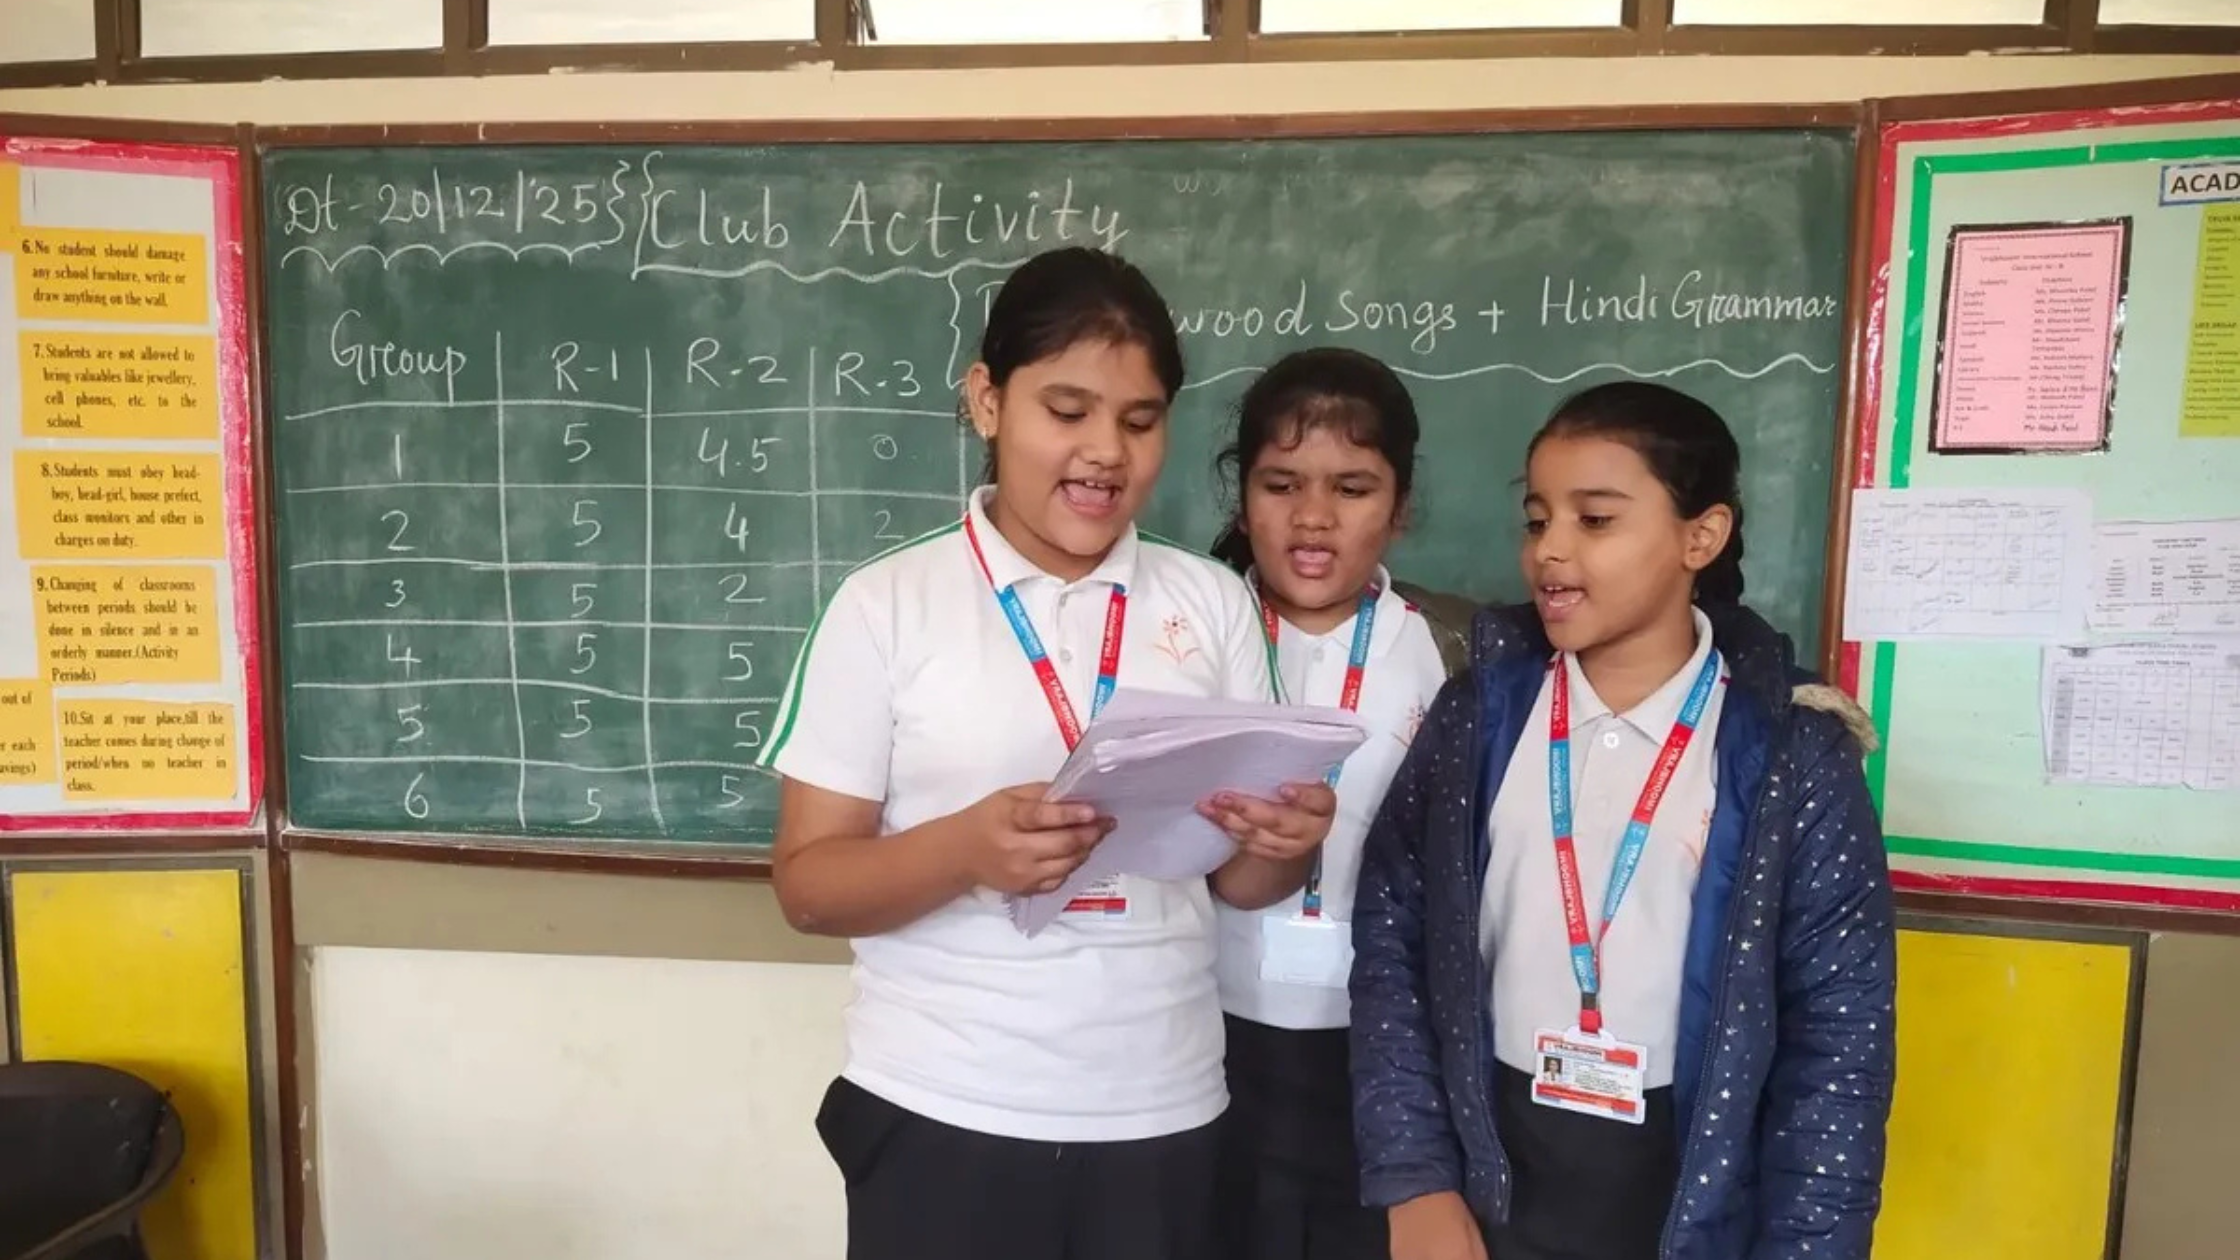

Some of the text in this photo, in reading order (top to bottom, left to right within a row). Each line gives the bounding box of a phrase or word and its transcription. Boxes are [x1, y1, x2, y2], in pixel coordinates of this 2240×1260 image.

[651, 178, 1129, 256] Club Activity
[58, 241, 96, 257] student
[104, 243, 138, 258] should
[146, 245, 185, 262] damage
[32, 267, 51, 281] any
[55, 264, 89, 280] school
[145, 271, 171, 283] write
[175, 274, 185, 284] or
[33, 288, 60, 302] draw
[63, 289, 107, 306] anything
[110, 295, 123, 305] on
[125, 291, 142, 305] the
[1325, 290, 1456, 355] Songs
[1478, 300, 1504, 334] +
[1541, 274, 1657, 326] Hindi
[96, 349, 113, 359] are
[119, 349, 135, 360] not
[141, 346, 179, 361] allowed
[184, 348, 194, 361] to
[552, 342, 618, 392] R-1
[687, 337, 788, 389] R-2
[836, 351, 922, 397] R-3
[43, 367, 71, 384] bring
[75, 368, 122, 383] valuables
[125, 369, 143, 383] like
[44, 391, 64, 405] cell
[158, 395, 169, 407] to
[181, 393, 197, 407] the
[394, 434, 402, 480] 1
[563, 423, 592, 462] 5
[698, 427, 781, 476] 4.5
[107, 466, 131, 478] must
[140, 465, 164, 481] obey
[130, 487, 159, 501] house
[53, 510, 204, 525] class monitors and other in
[382, 500, 905, 552] 2 5 4 2
[55, 532, 94, 548] charges
[97, 536, 110, 546] on
[113, 577, 123, 590] of
[139, 577, 195, 592] classrooms
[386, 574, 766, 619] 3 5 2
[46, 600, 197, 615] between periods should be
[48, 622, 199, 637] done in silence and in an
[50, 645, 87, 661] orderly
[387, 633, 754, 681] 4 5 5
[104, 714, 113, 725] at
[123, 715, 146, 727] your
[208, 712, 224, 725] the
[397, 699, 762, 748] 5 5 5
[63, 734, 225, 749] teacher comes during change of
[142, 760, 155, 769] no
[167, 756, 202, 769] teacher
[216, 756, 226, 769] in
[405, 773, 745, 824] 6 5 5
